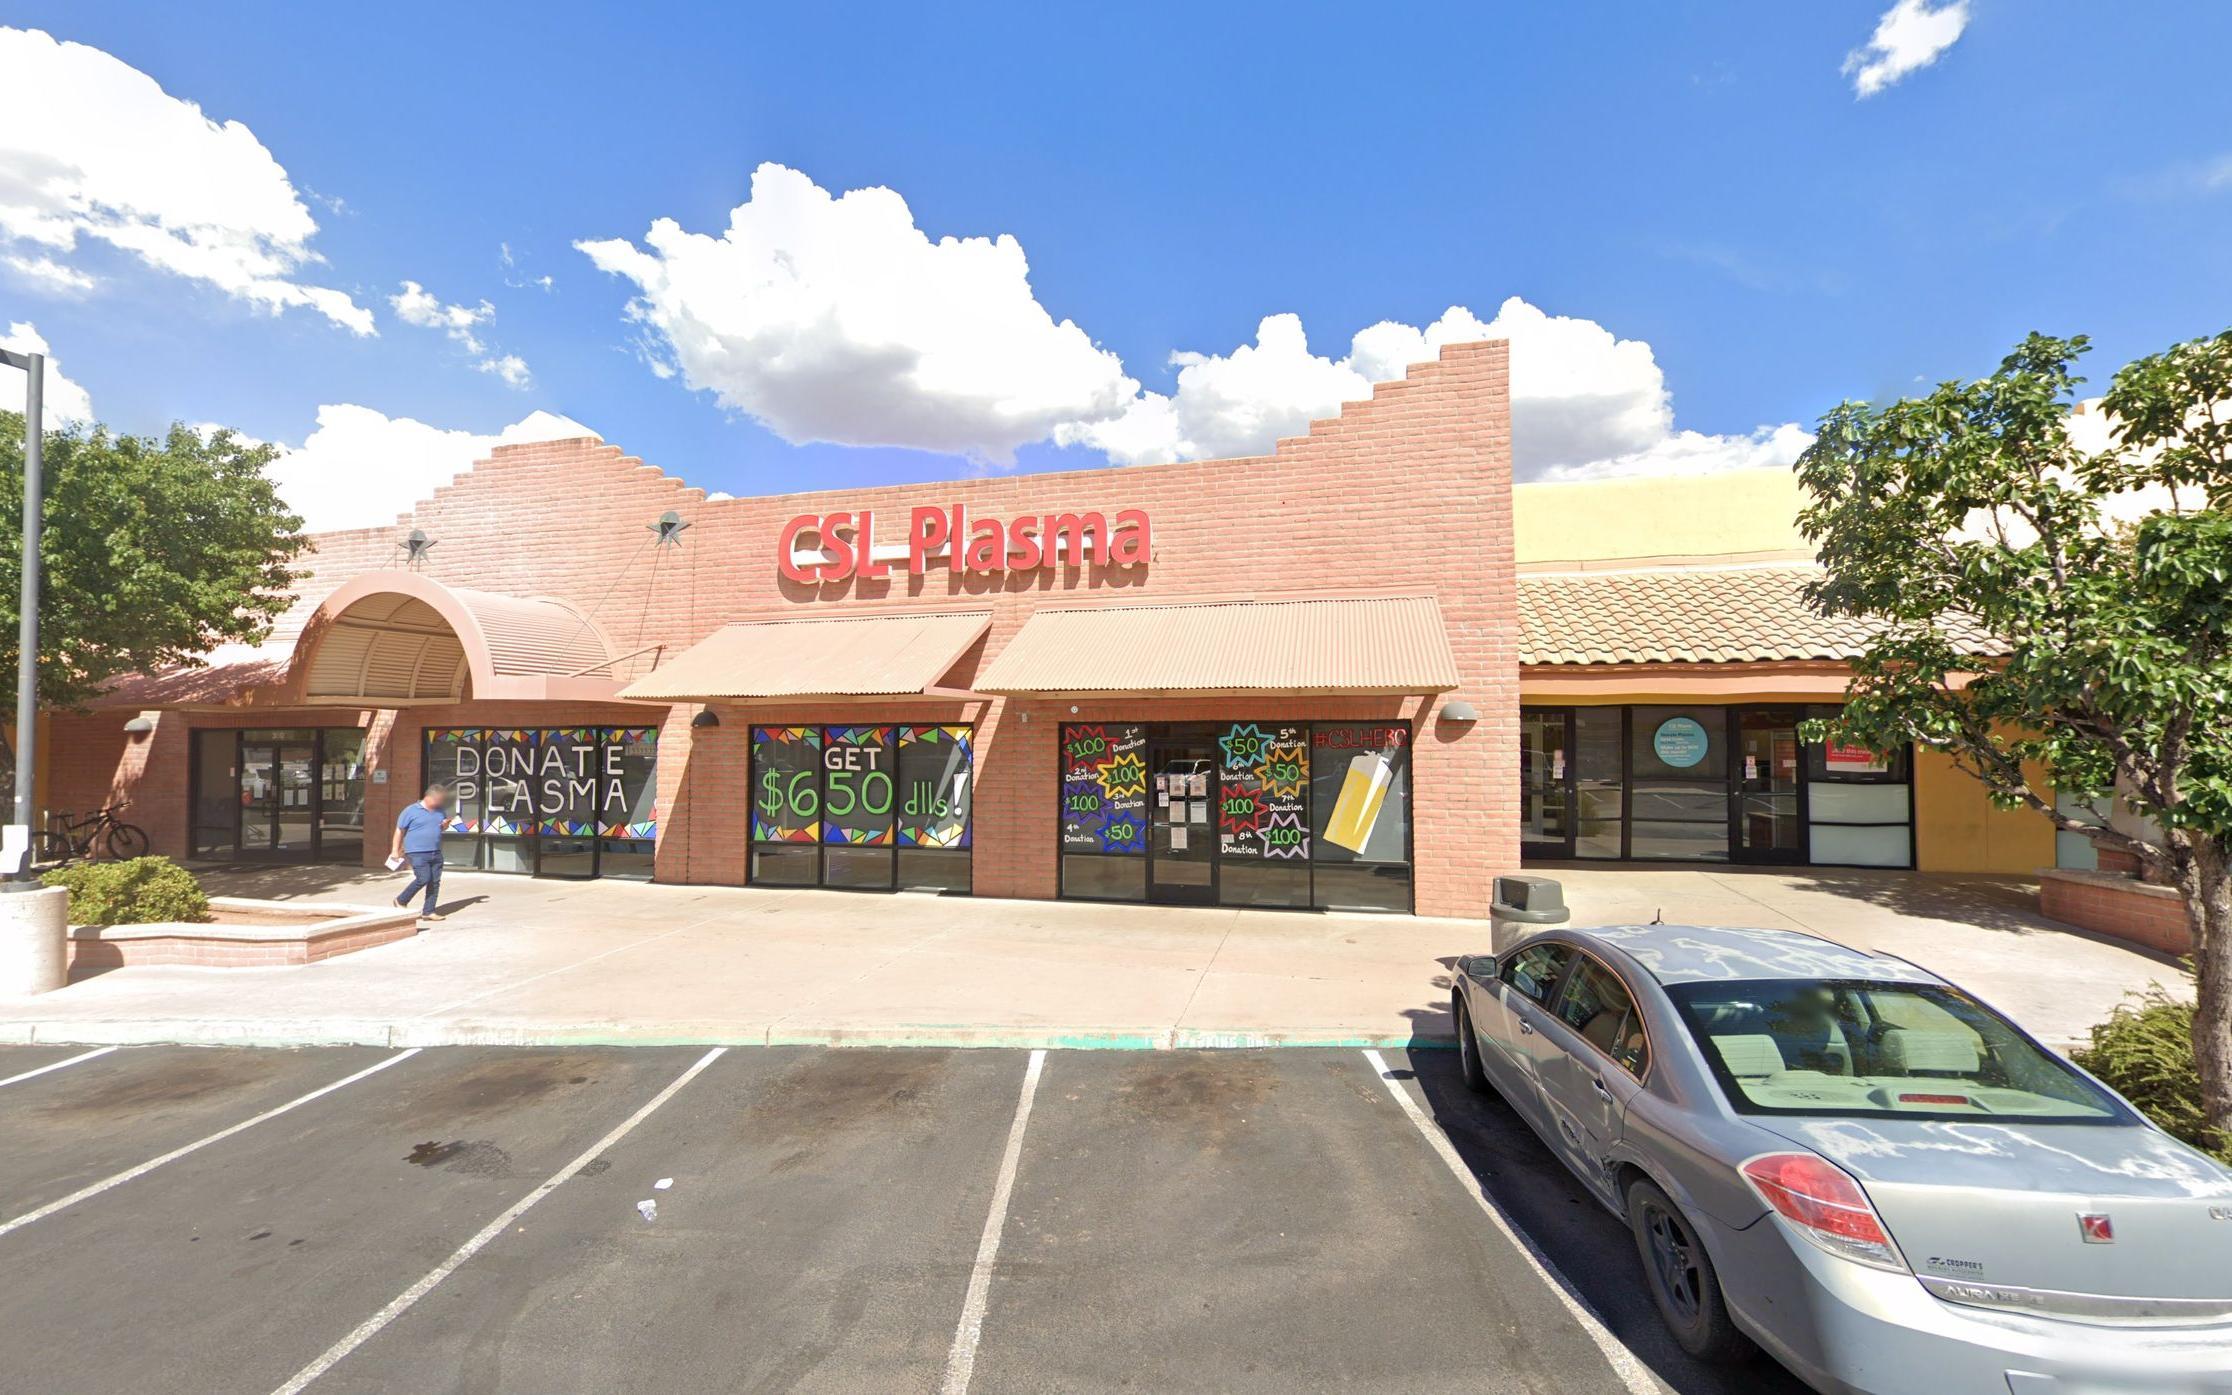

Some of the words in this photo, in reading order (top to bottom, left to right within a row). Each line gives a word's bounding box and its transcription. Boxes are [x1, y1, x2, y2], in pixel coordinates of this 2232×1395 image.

[778, 511, 893, 584] CSL
[908, 503, 1153, 576] Plasma
[1280, 728, 1296, 739] 5th
[1067, 736, 1105, 758] $100
[1112, 738, 1146, 752] Donation
[1226, 737, 1259, 755] $50
[1270, 740, 1307, 750] Donation
[456, 745, 624, 778] DONATE
[824, 747, 882, 771] GET
[1065, 771, 1100, 782] Donation
[1220, 771, 1255, 781] Donation
[1265, 764, 1300, 781] $50
[456, 778, 628, 815] PLASMA
[758, 768, 893, 818] $650
[1114, 799, 1144, 809] Donation
[1221, 798, 1255, 814] $100
[1269, 803, 1304, 812] Donation
[1064, 834, 1095, 843] Donation
[1104, 823, 1133, 840] $50
[1239, 831, 1253, 840] 8th
[1264, 829, 1301, 845] $100
[1221, 843, 1259, 855] Donation
[1946, 1259, 1984, 1270] CROPPER'S
[1946, 1285, 1996, 1300] AURA
